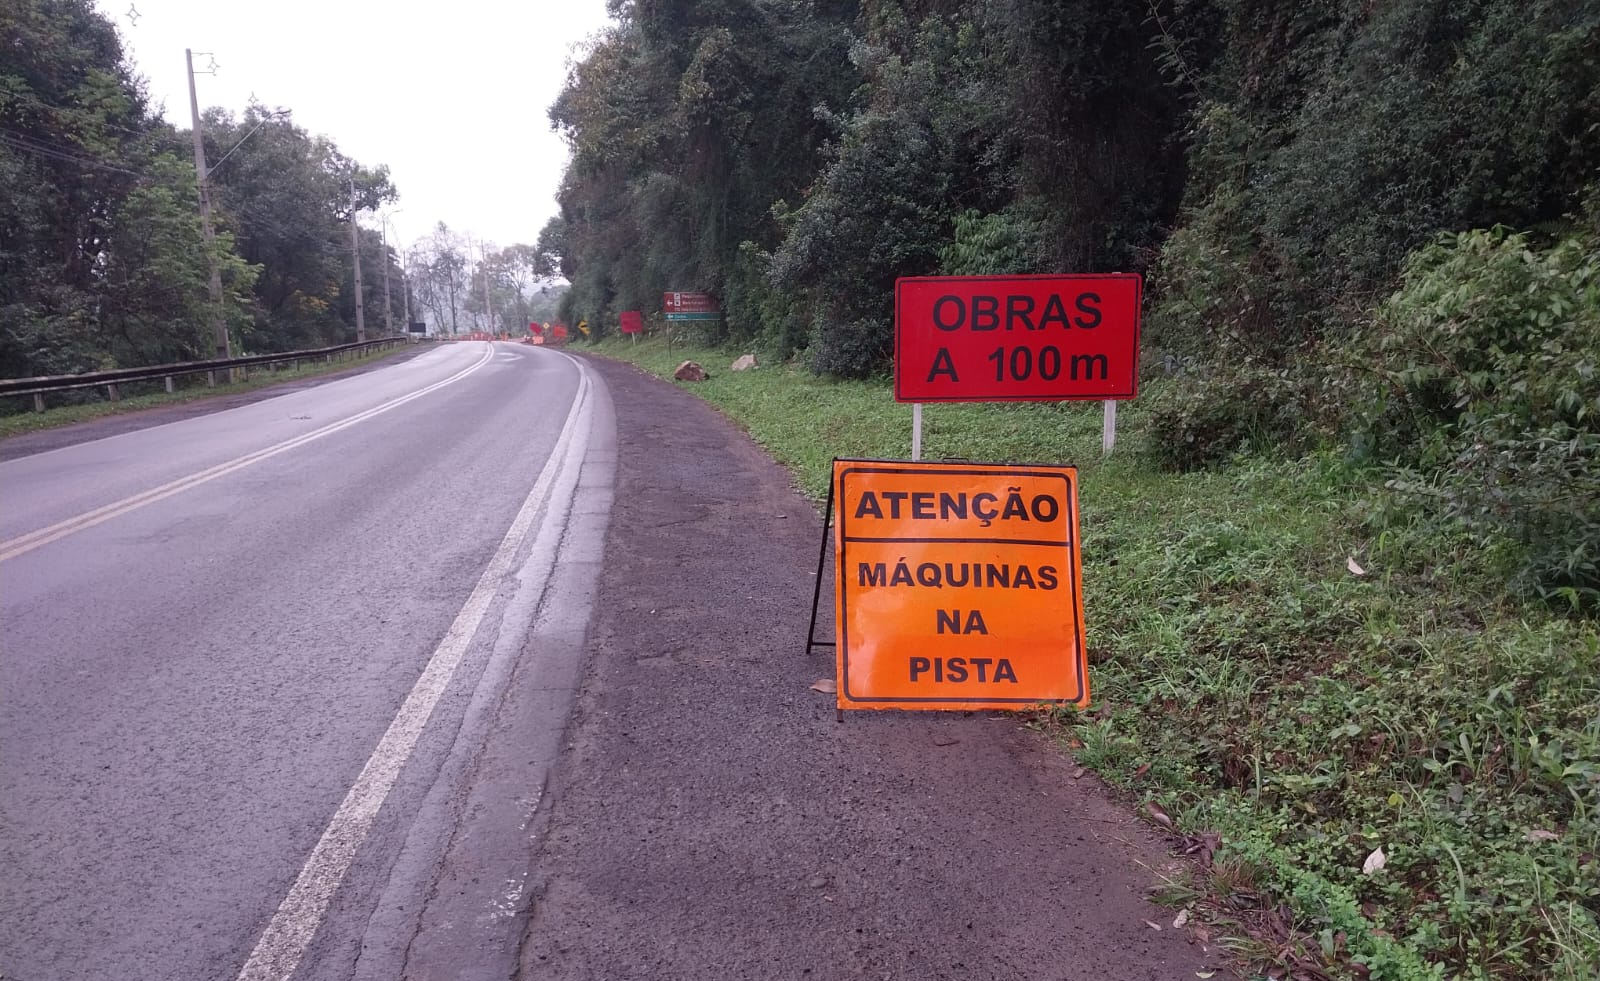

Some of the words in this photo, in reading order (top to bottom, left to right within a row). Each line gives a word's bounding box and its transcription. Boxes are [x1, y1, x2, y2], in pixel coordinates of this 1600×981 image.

[933, 294, 1102, 331] OBRAS
[927, 348, 959, 382] A
[854, 487, 1059, 527] ATENÇÃO
[858, 557, 1058, 590] MÁQUINAS
[936, 610, 988, 635] NA
[909, 657, 1018, 683] PISTA
